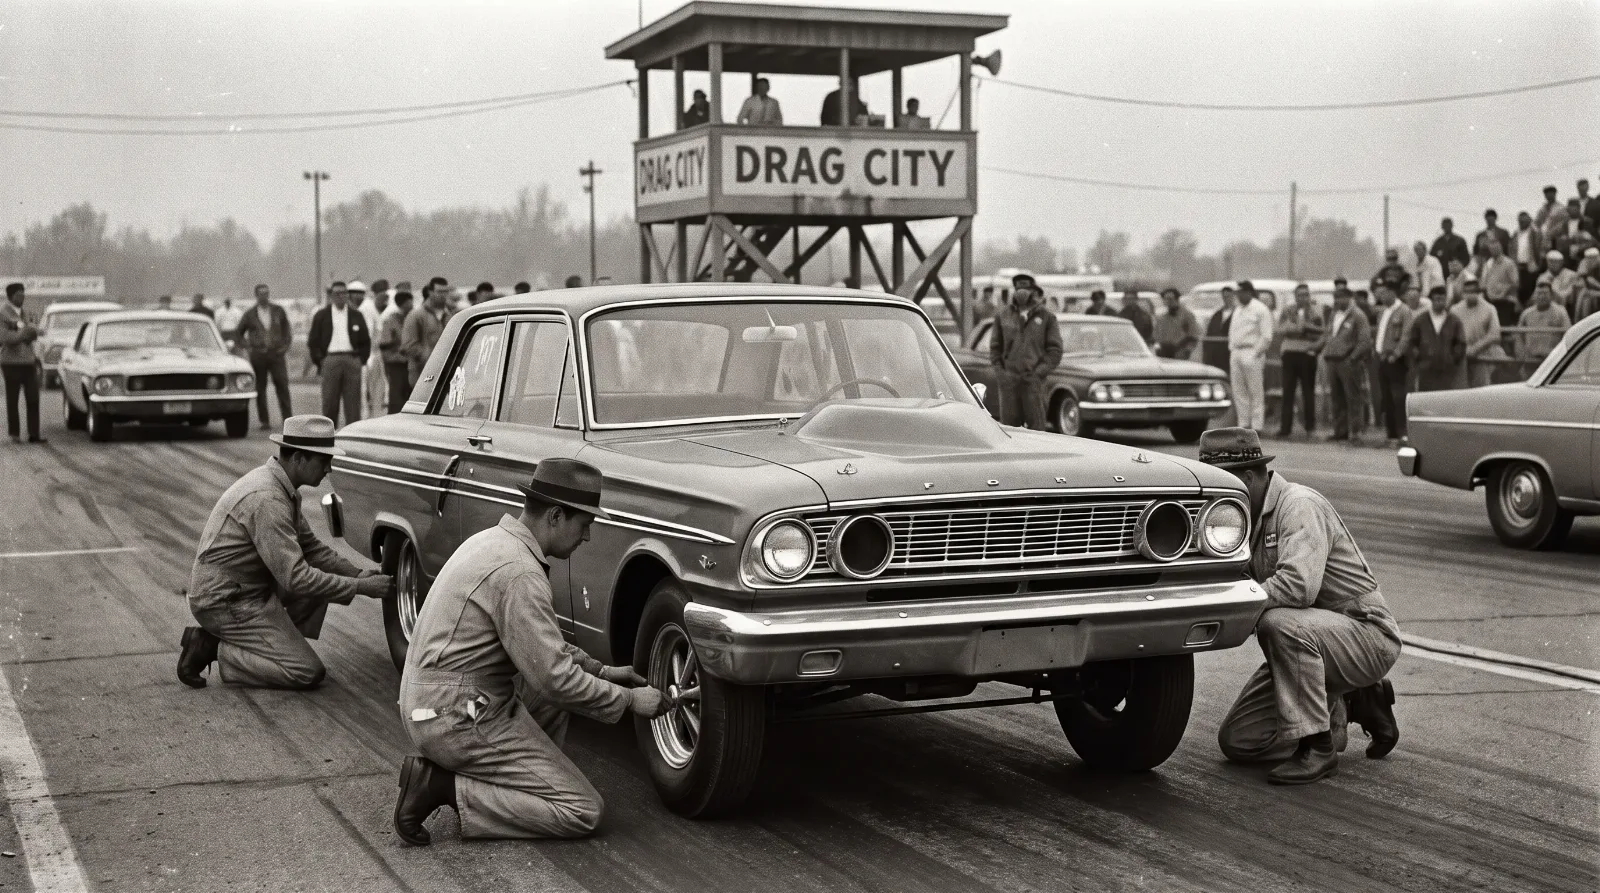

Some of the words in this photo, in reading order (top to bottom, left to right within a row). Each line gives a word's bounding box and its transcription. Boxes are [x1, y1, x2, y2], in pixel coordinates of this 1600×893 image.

[639, 152, 672, 195] DRAG
[675, 147, 705, 188] CITY
[735, 145, 845, 184] DRAG
[863, 149, 954, 187] CITY
